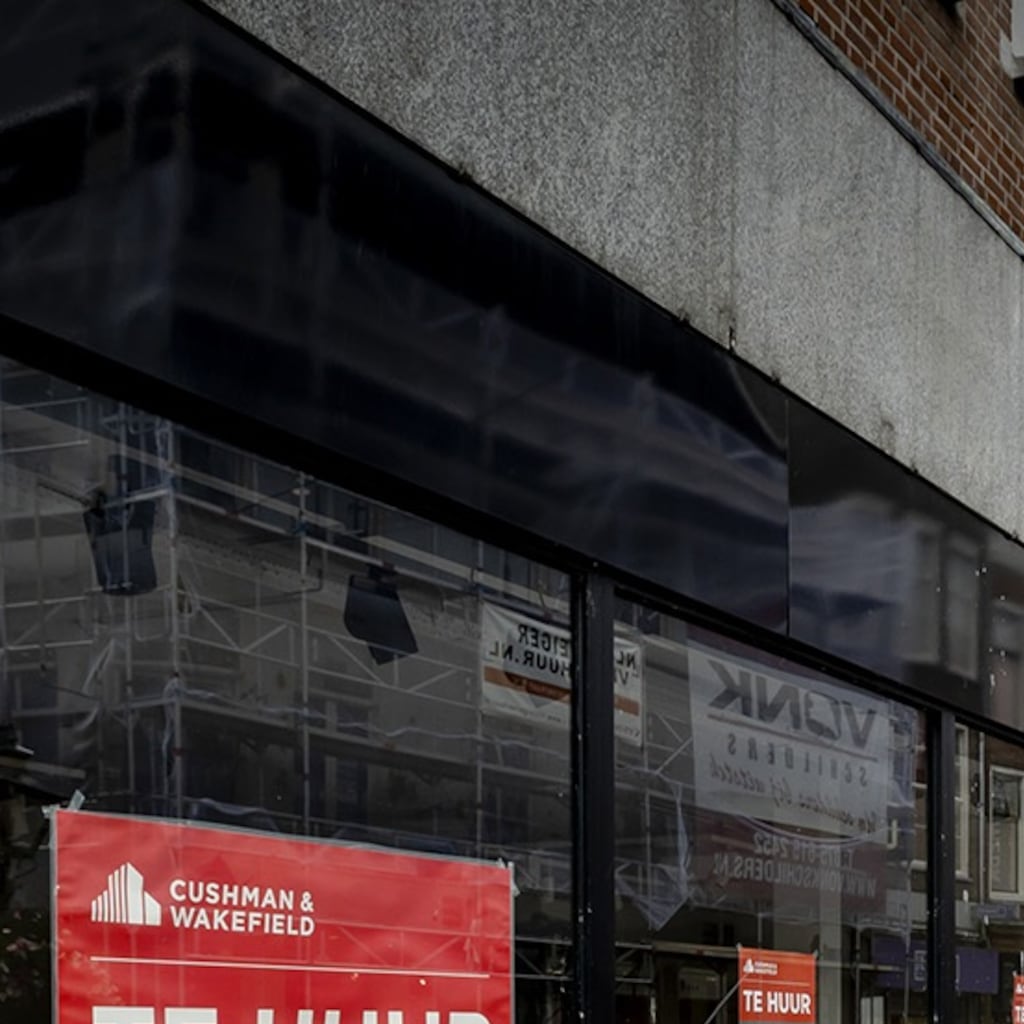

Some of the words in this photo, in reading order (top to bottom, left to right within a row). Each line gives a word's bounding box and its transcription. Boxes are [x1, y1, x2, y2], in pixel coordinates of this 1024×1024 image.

[169, 879, 294, 910] CUSHMAN
[300, 892, 314, 912] &
[169, 905, 316, 937] WAKEFIELD
[742, 989, 764, 1012] TE
[766, 991, 812, 1015] HUUR
